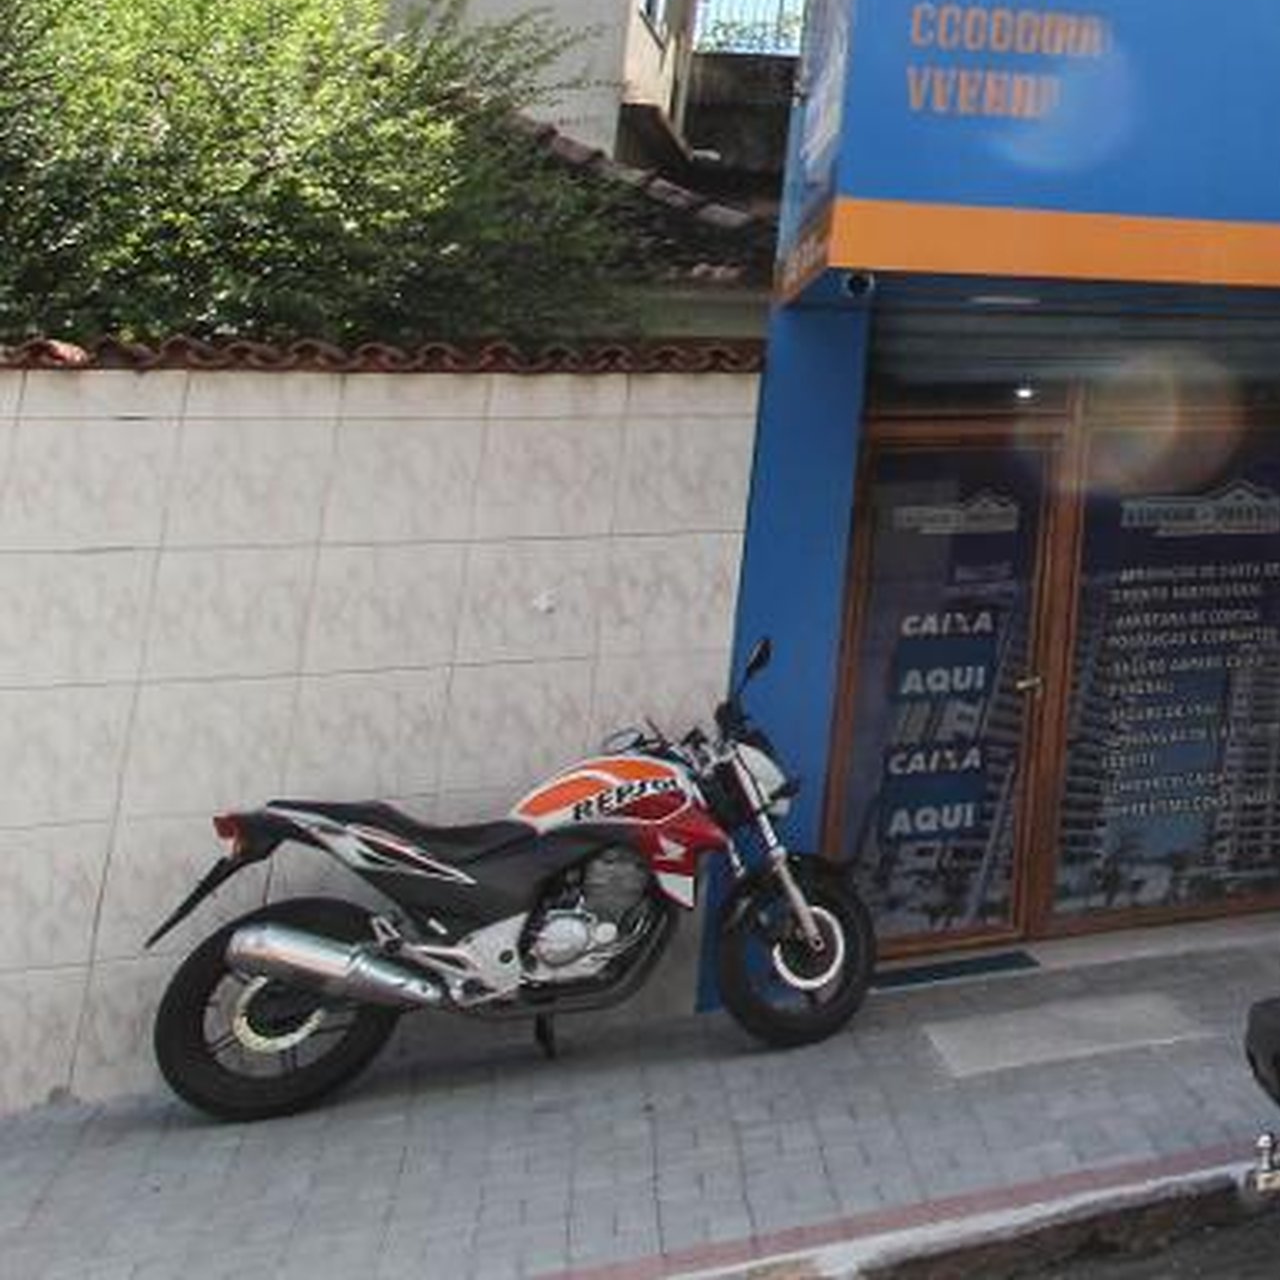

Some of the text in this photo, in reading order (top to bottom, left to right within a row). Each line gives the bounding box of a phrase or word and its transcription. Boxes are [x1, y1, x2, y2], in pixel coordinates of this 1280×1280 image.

[900, 612, 994, 636] CAIXA
[901, 666, 985, 694] AQUI
[888, 748, 982, 775] CAIXA
[888, 803, 975, 836] AQUI
